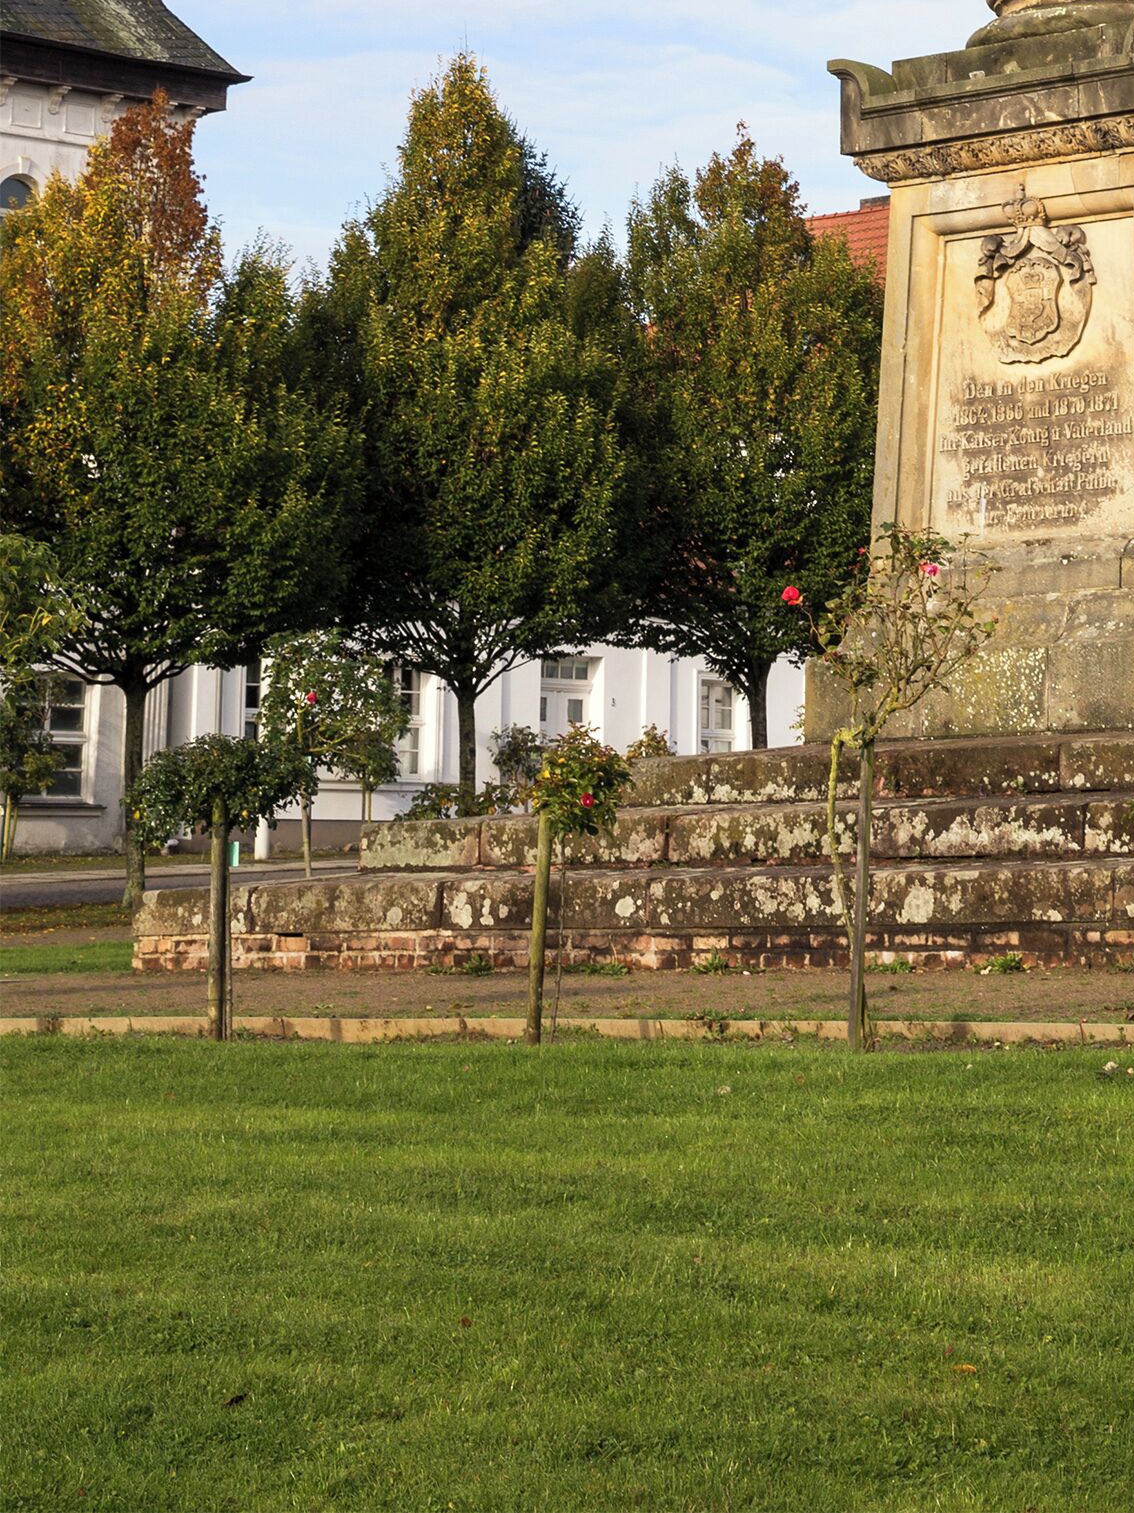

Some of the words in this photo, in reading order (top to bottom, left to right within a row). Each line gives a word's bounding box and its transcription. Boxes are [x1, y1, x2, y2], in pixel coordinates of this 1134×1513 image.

[963, 379, 994, 400] Den
[1018, 376, 1044, 395] den
[1049, 370, 1108, 394] Kriegen
